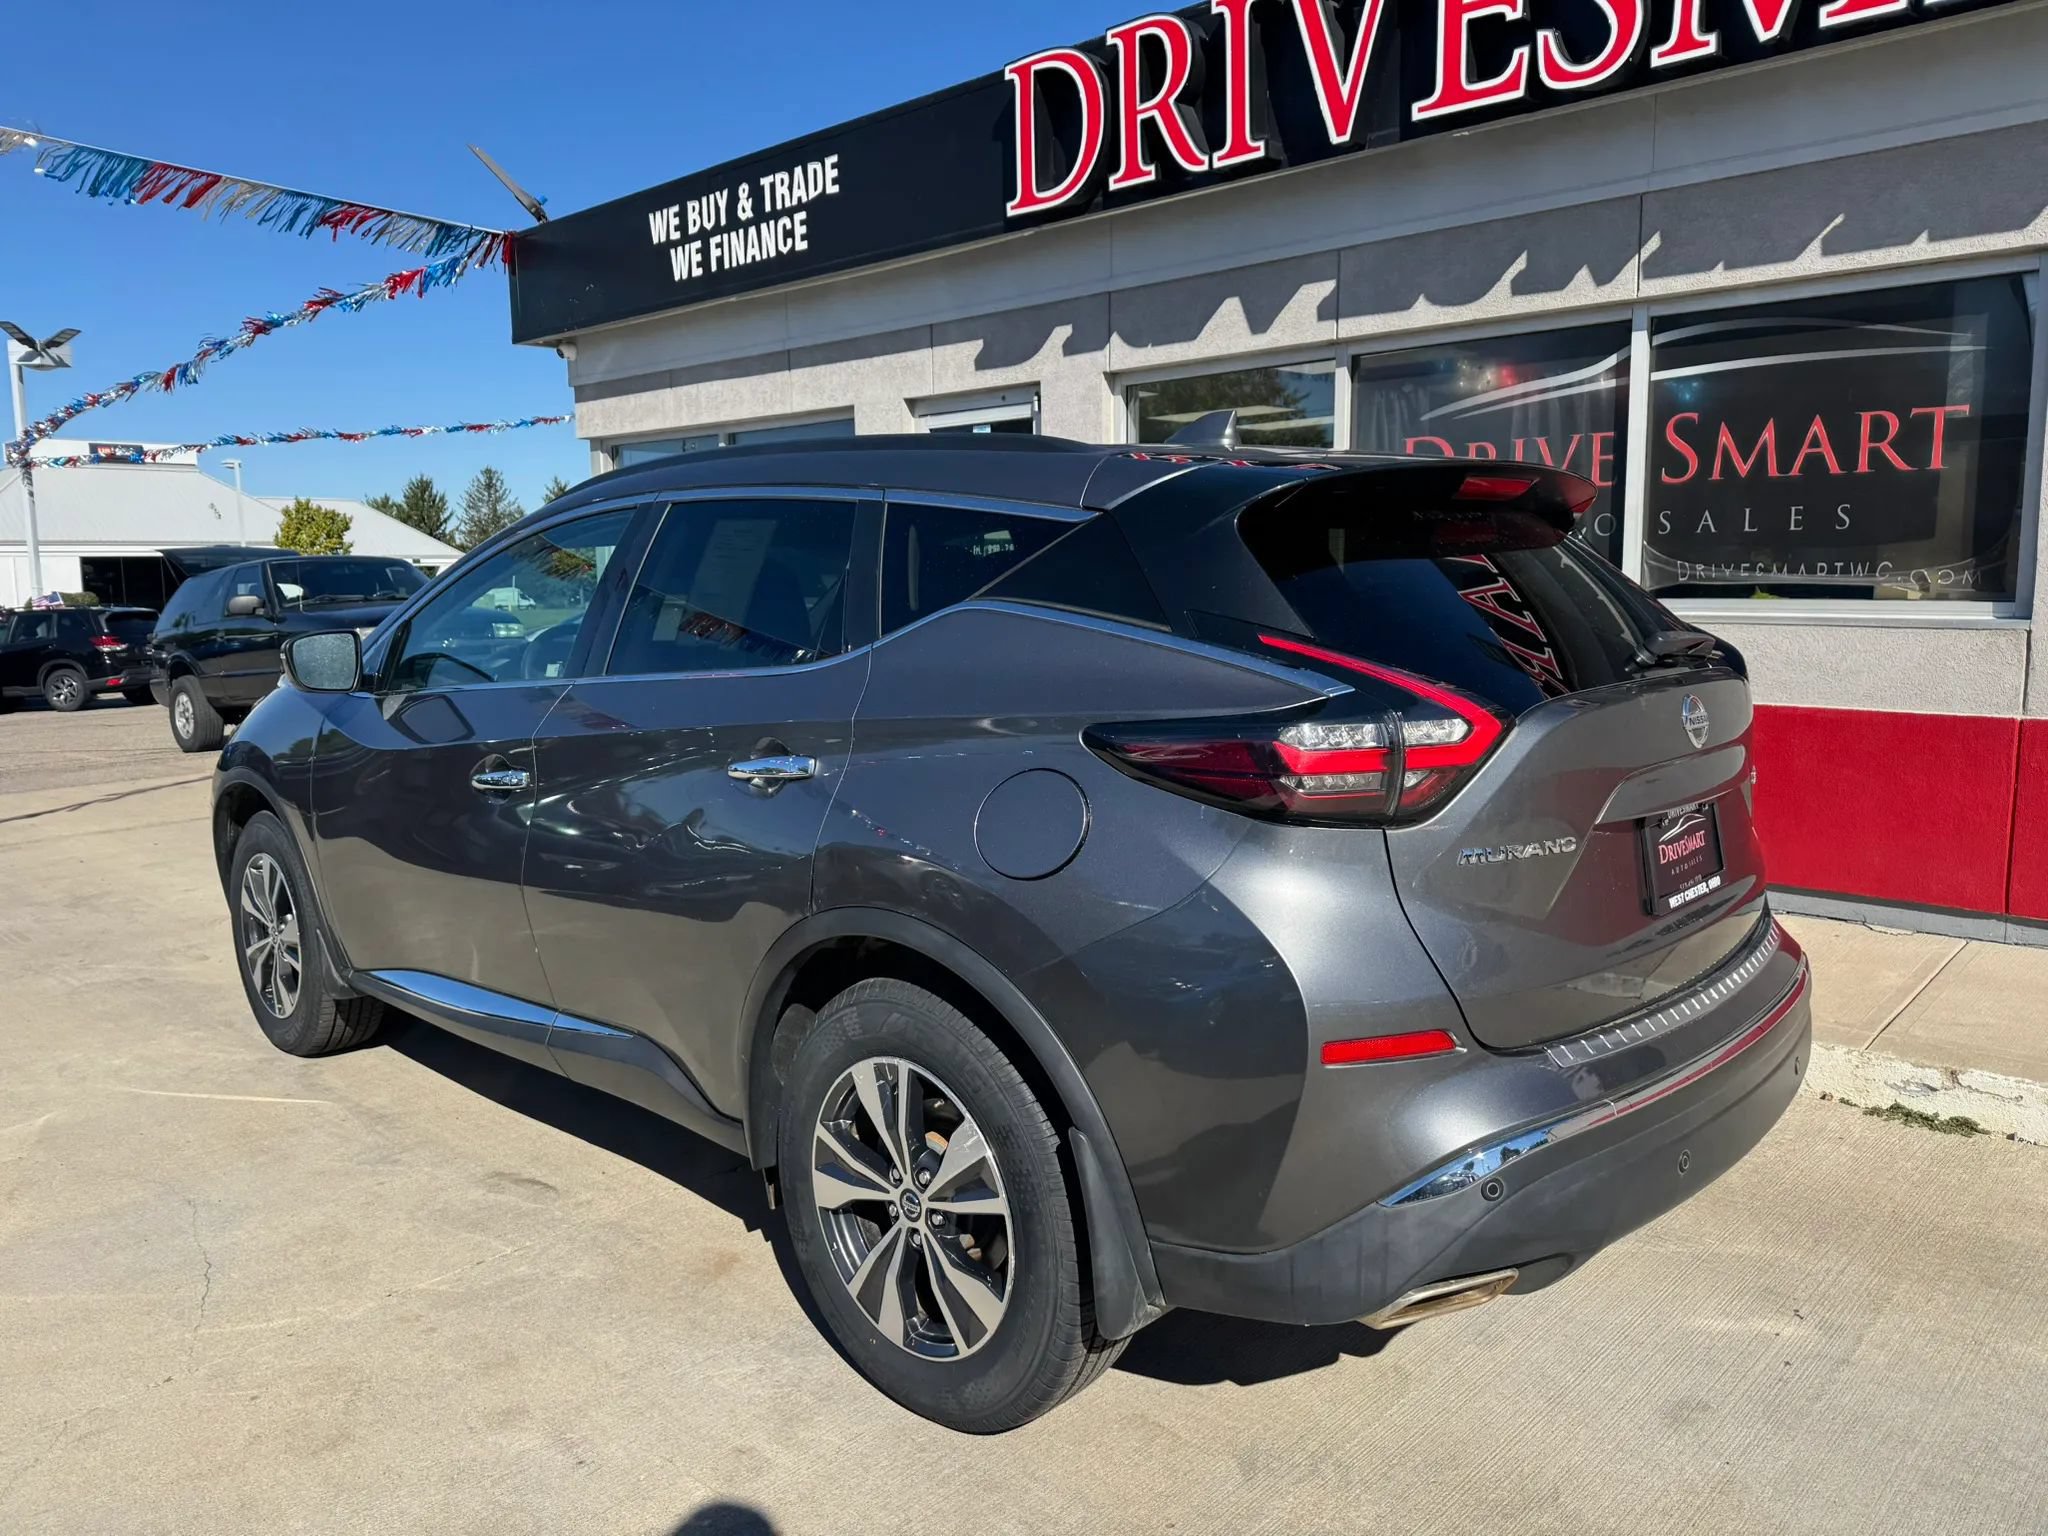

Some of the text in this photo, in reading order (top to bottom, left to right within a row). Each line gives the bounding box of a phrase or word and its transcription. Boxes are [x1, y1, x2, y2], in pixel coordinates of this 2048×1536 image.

[649, 153, 840, 245] WE BUY & TRADE
[670, 211, 808, 282] WE FINANCE
[1661, 403, 1970, 484] SMART
[1658, 504, 1850, 534] SALES
[1457, 836, 1577, 866] MURANO
[1668, 891, 1685, 909] WEST
